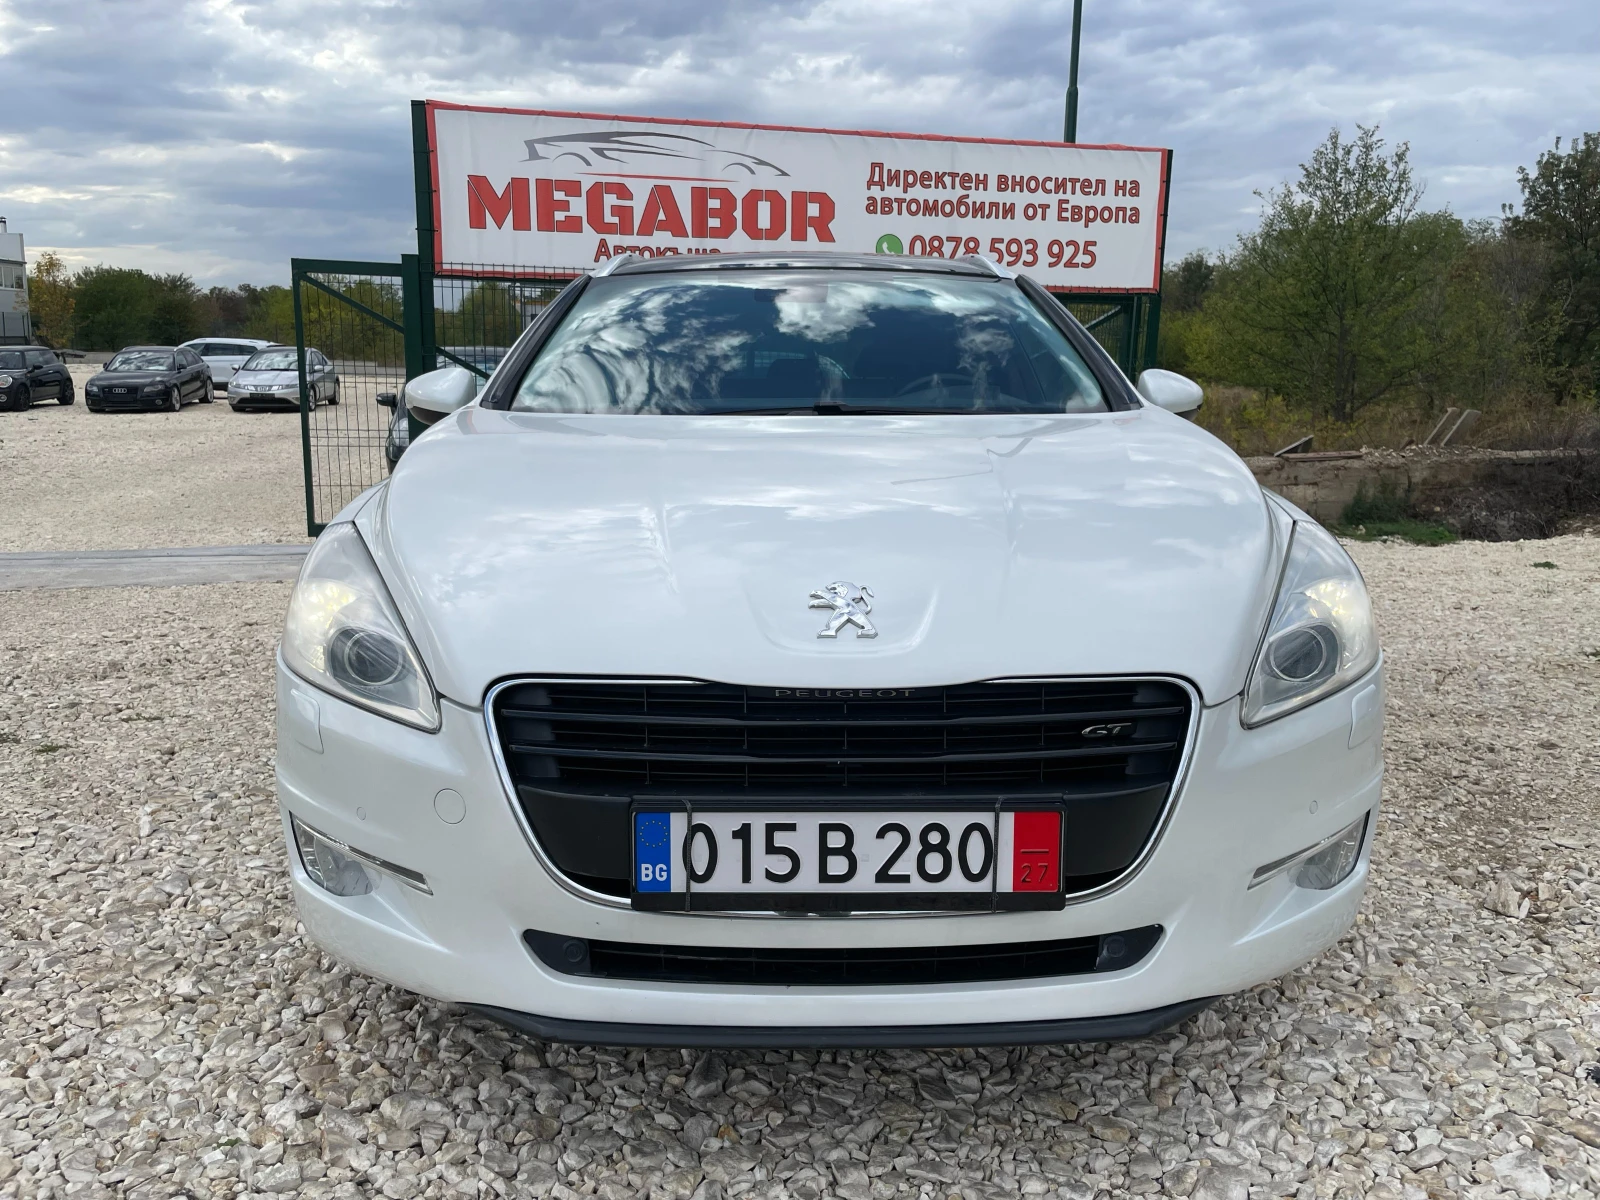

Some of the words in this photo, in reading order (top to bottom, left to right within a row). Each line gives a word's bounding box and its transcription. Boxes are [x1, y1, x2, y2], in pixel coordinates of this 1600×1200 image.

[866, 162, 989, 192] Директен
[996, 174, 1106, 197] вносител
[1114, 179, 1141, 198] на
[467, 174, 837, 243] MEGABOR
[865, 194, 1016, 221] автомобили
[1023, 203, 1050, 221] от
[1057, 199, 1141, 228] Европа
[908, 235, 981, 260] 0878
[989, 237, 1039, 267] 593
[1047, 239, 1097, 268] 925
[775, 689, 916, 698] PEUGEOT
[1081, 722, 1133, 738] GT
[641, 863, 668, 882] BG
[1021, 863, 1048, 883] 27
